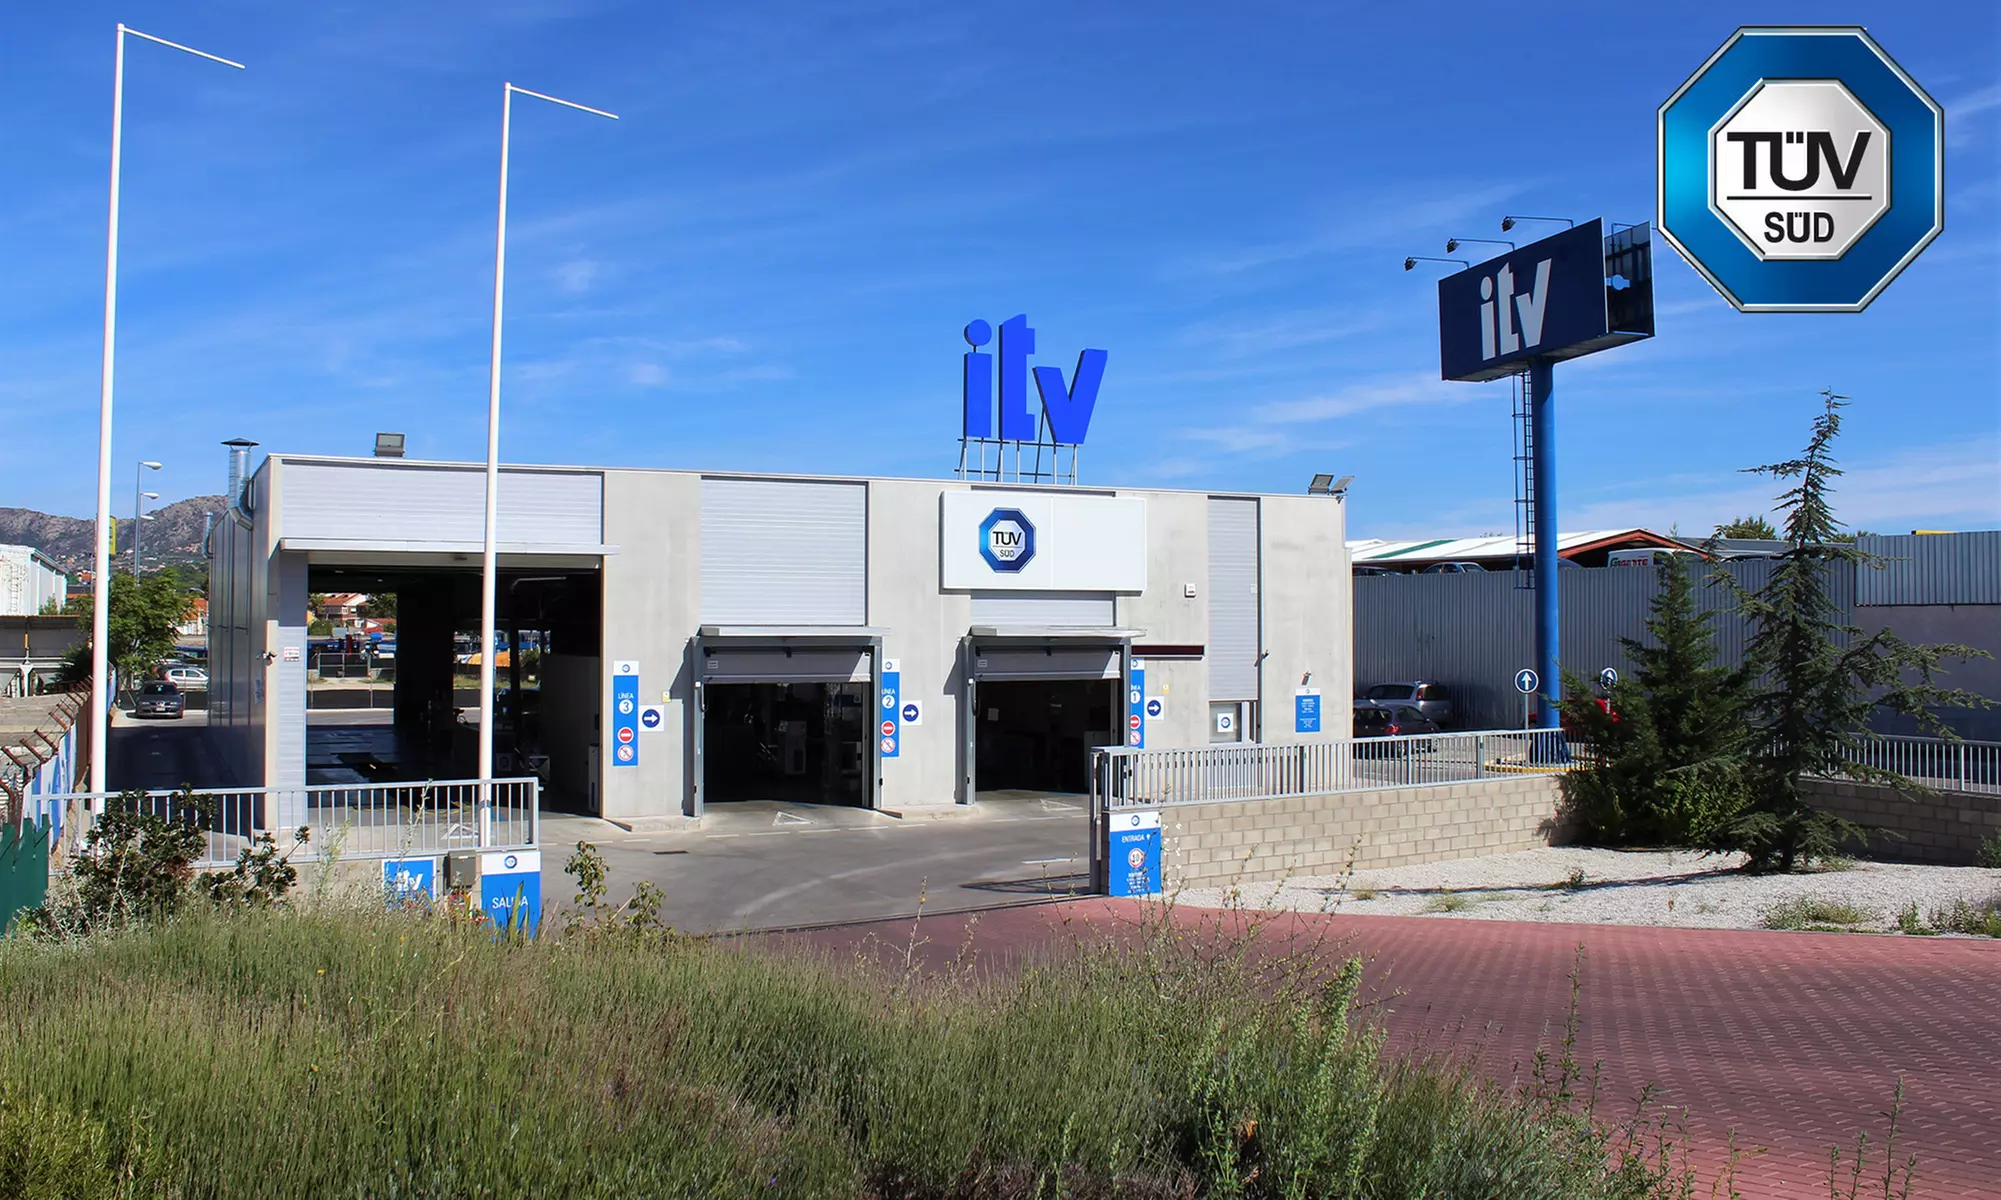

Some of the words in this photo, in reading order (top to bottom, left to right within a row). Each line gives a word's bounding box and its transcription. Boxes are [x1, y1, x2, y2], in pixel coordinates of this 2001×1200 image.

[1480, 258, 1552, 361] itv
[964, 314, 1108, 444] itv
[992, 531, 1022, 545] TÜV
[1000, 549, 1014, 557] SÜD
[623, 702, 630, 712] 3
[886, 697, 891, 707] 2
[1121, 834, 1145, 843] ENTRADA
[492, 896, 528, 909] SALIA
